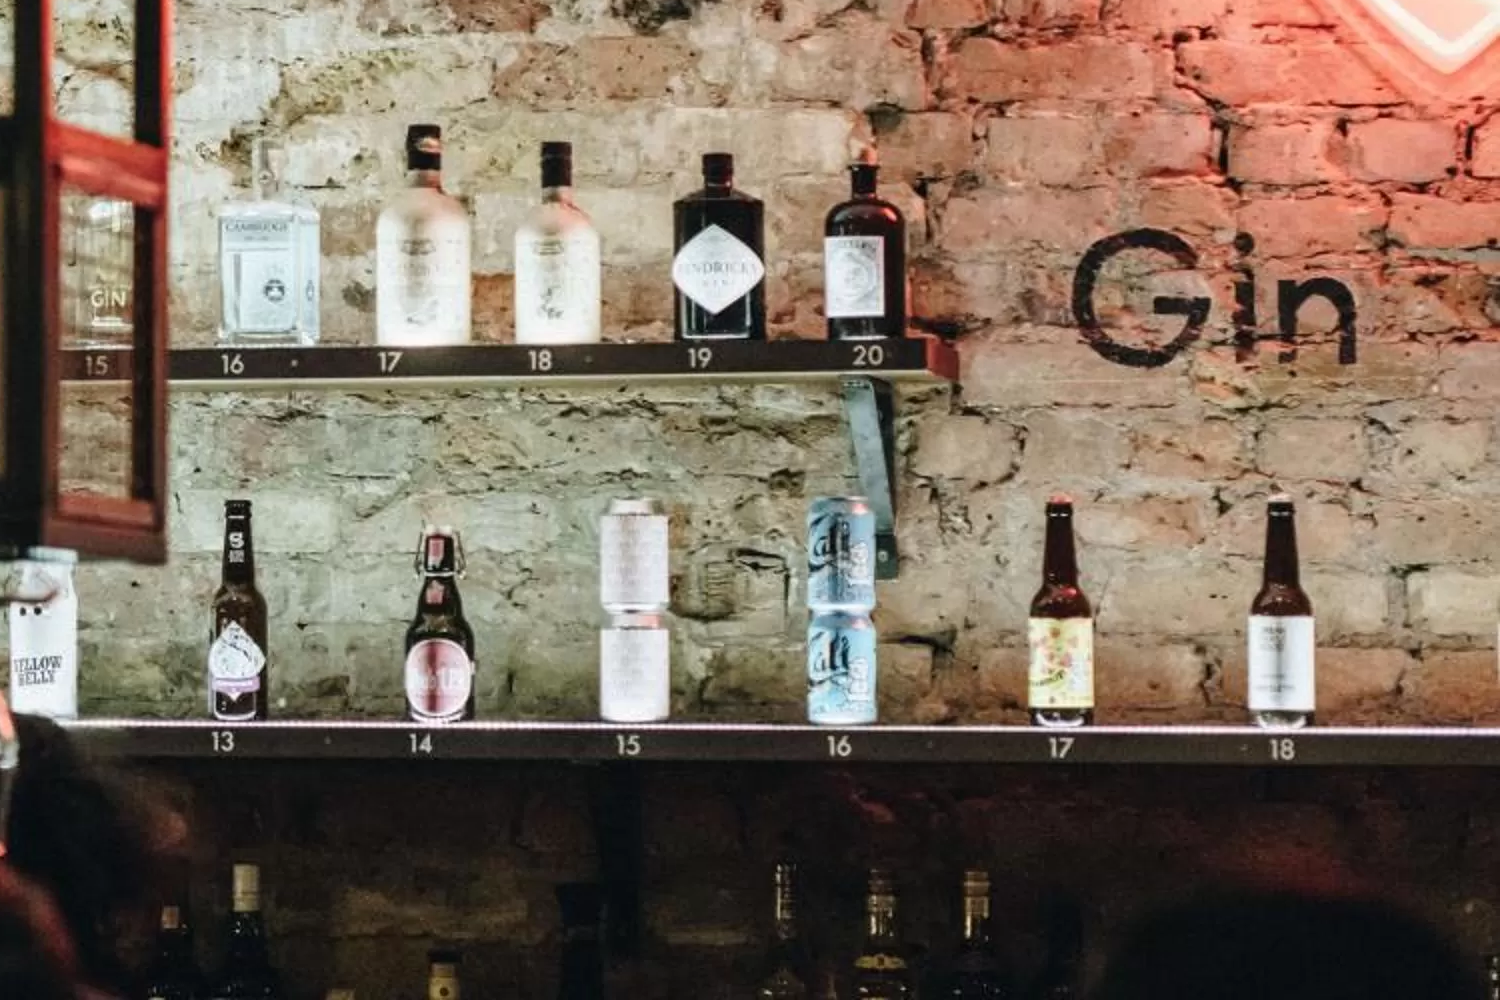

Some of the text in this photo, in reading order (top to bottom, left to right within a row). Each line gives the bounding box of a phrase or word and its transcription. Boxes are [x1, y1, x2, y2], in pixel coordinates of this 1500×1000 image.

[91, 290, 127, 309] GIN
[1072, 228, 1358, 368] Gin
[85, 355, 109, 377] 15
[221, 354, 245, 375] 16
[378, 352, 404, 373] 17
[528, 350, 553, 371] 18
[687, 347, 713, 368] 19
[852, 345, 884, 366] 20
[13, 655, 62, 672] YELLOW
[19, 670, 55, 687] BELLY
[210, 731, 235, 752] 13
[409, 733, 433, 754] 14
[616, 734, 642, 756] 15
[827, 735, 853, 757] 16
[1049, 737, 1075, 759] 17
[1270, 738, 1296, 761] 18
